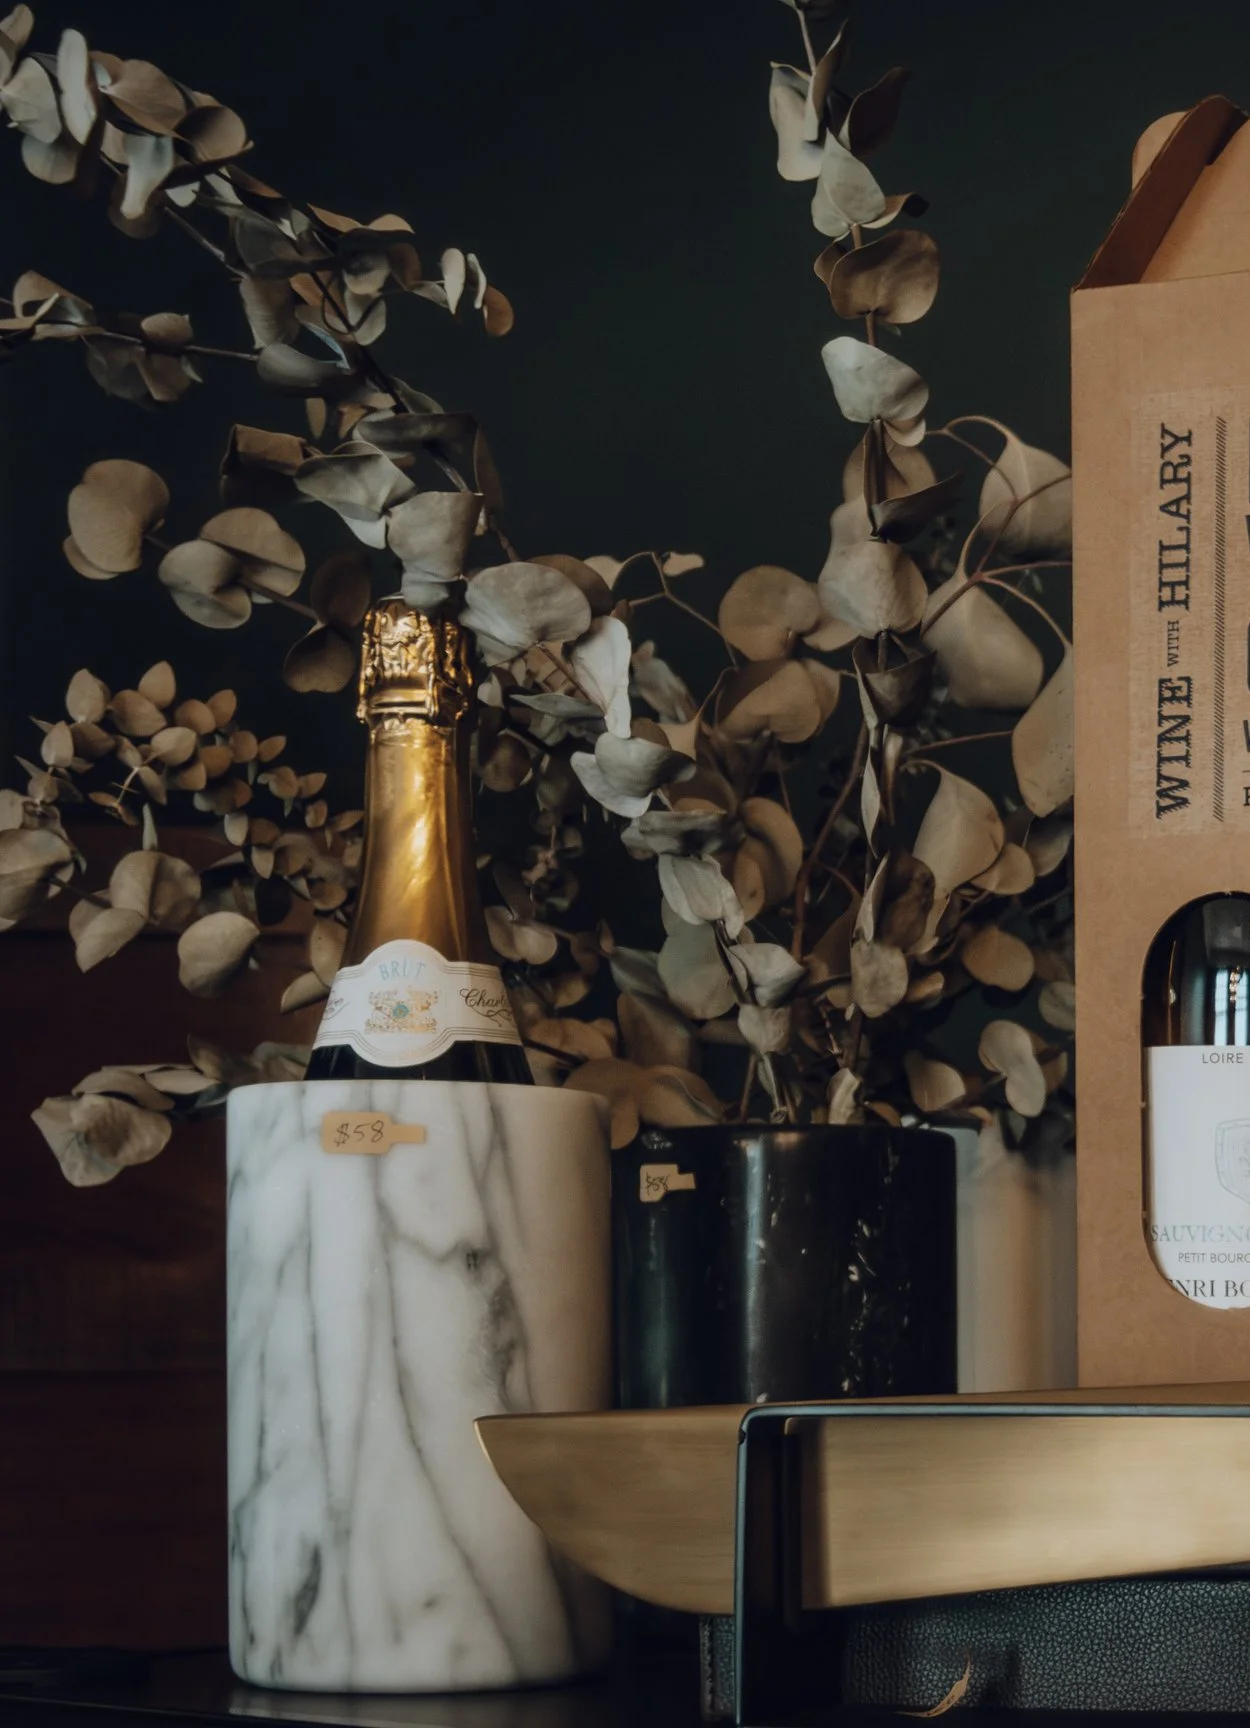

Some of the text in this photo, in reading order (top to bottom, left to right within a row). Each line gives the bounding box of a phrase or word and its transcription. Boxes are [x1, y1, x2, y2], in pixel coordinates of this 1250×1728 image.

[1155, 423, 1193, 819] WINE WITH HILARY
[378, 957, 427, 981] BRUT
[1202, 1052, 1244, 1064] LOIRE
[334, 1119, 385, 1147] $58
[1177, 1252, 1206, 1264] PETIT
